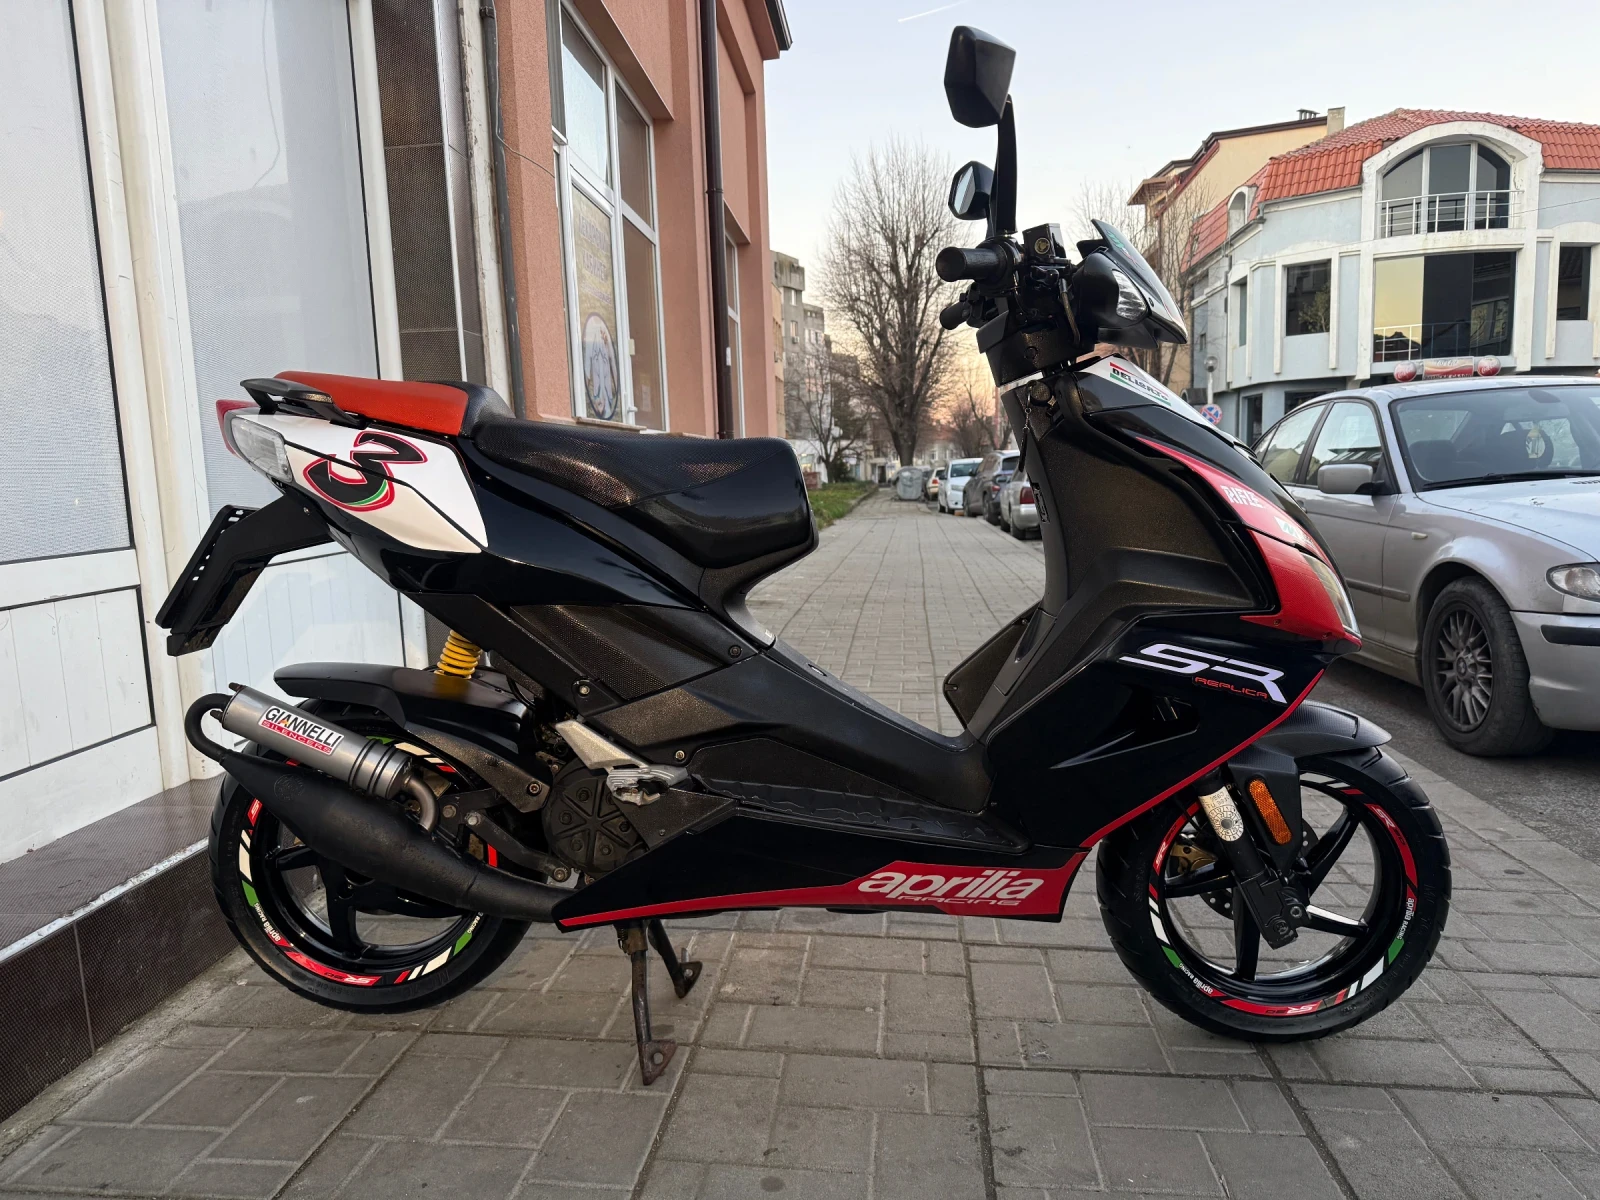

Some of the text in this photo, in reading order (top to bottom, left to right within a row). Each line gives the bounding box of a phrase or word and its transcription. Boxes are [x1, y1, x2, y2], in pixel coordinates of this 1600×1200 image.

[1119, 643, 1288, 704] SR
[1195, 676, 1268, 700] REPLICA
[262, 720, 332, 754] SILENCERS
[265, 707, 342, 748] GIANNELLI
[858, 869, 1045, 899] aprilia
[898, 895, 1021, 906] RACING
[254, 902, 282, 942] aprilia RACING
[1396, 897, 1415, 940] aprilia RACING
[1178, 963, 1214, 994] aprilia RACING
